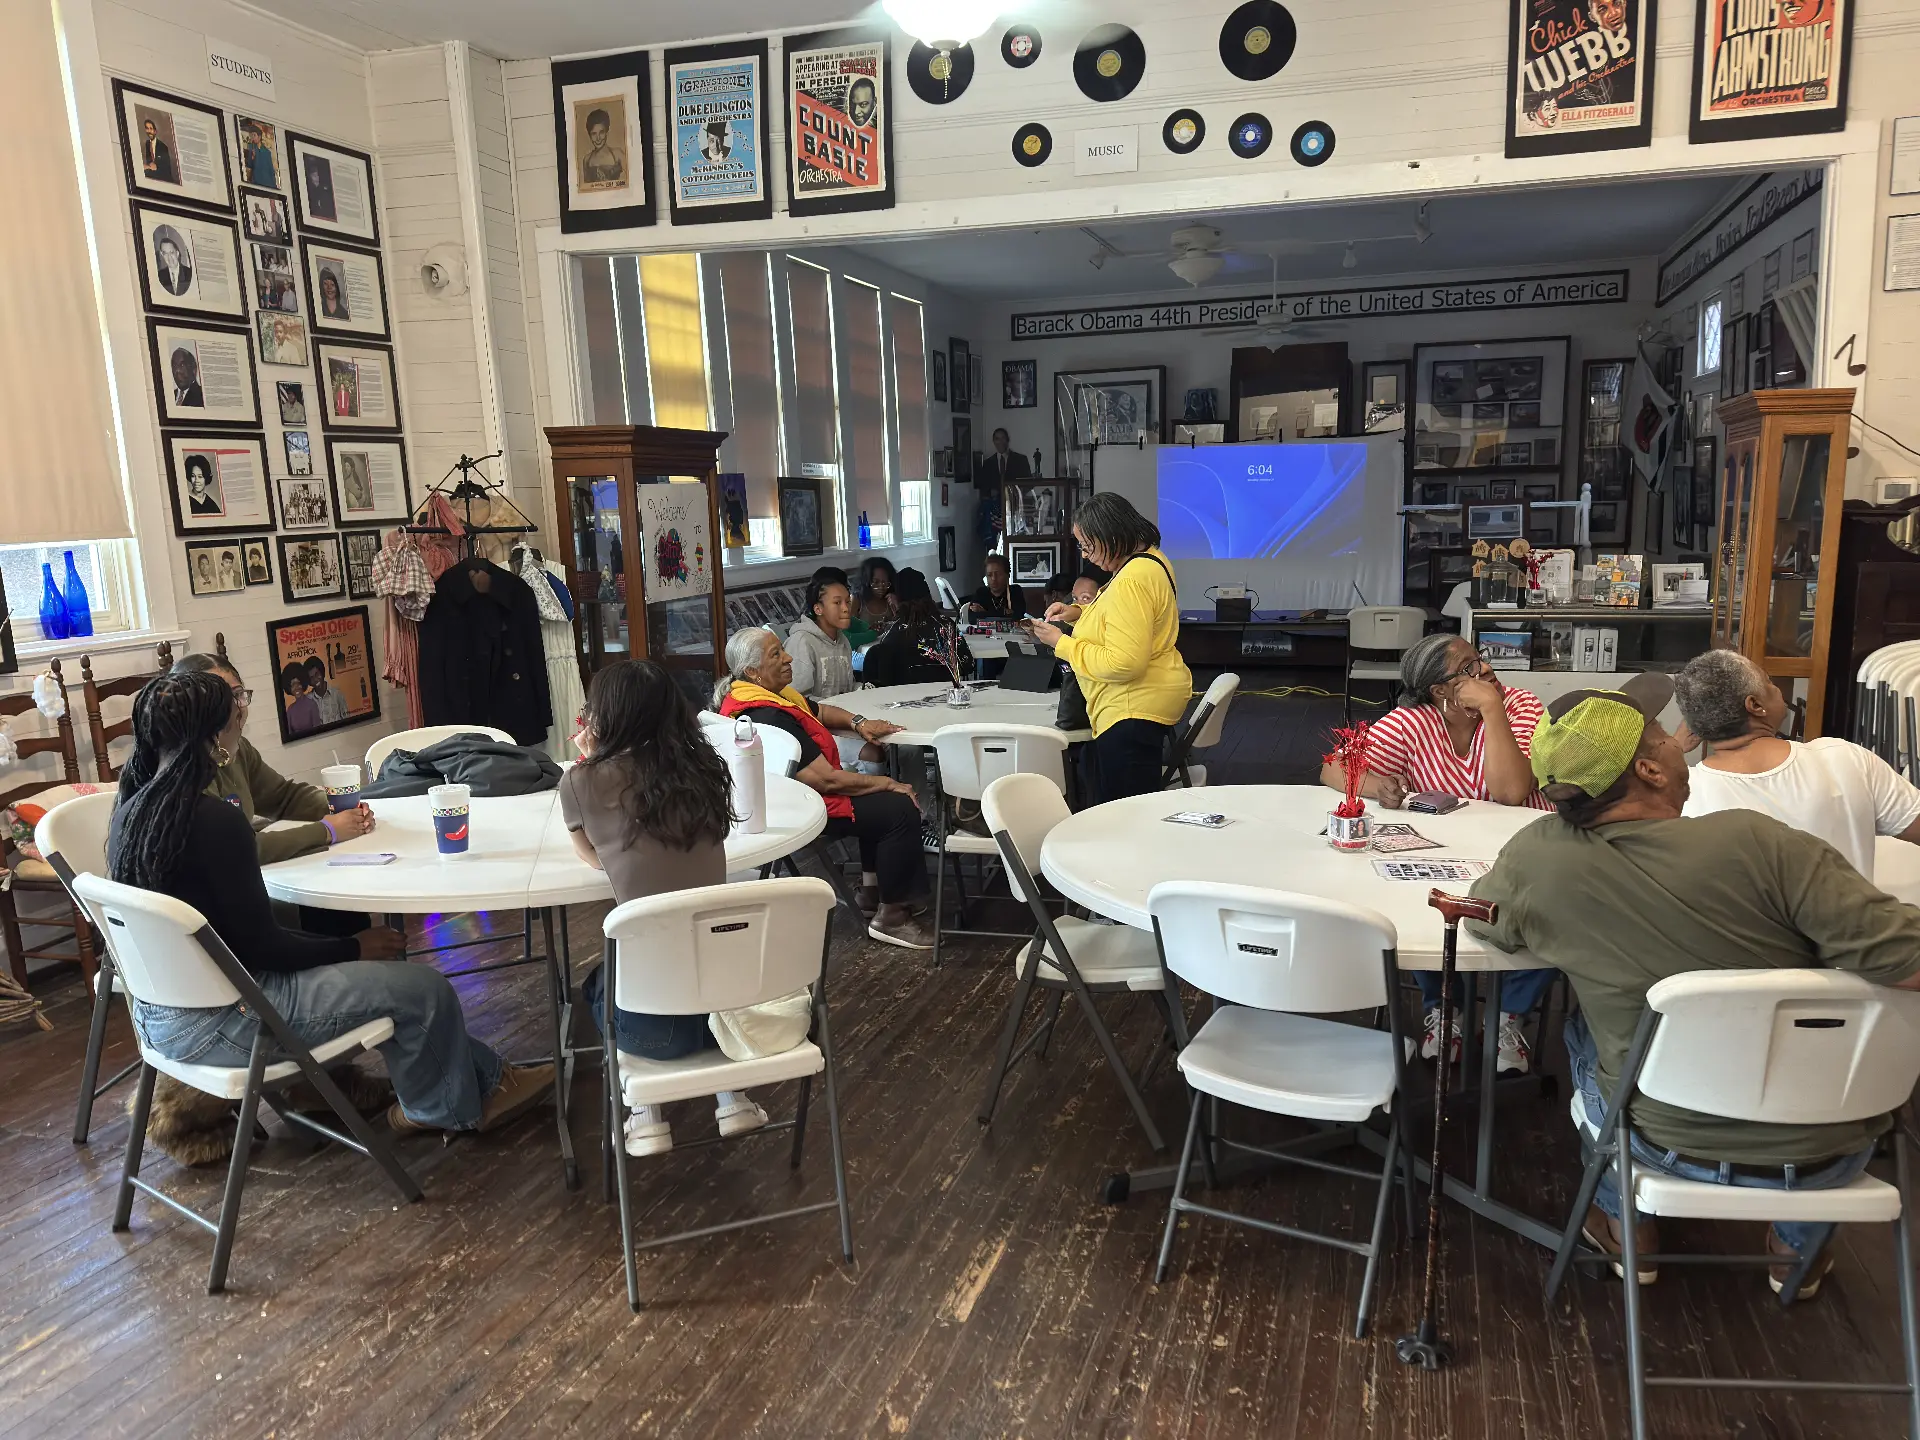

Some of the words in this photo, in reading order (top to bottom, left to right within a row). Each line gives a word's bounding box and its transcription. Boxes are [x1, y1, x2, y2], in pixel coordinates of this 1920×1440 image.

[1531, 8, 1589, 53] Chick
[1524, 22, 1631, 92] WEBB
[1711, 20, 1832, 101] ARMSTRONG
[211, 54, 272, 84] STUDENTS
[796, 61, 830, 74] APPEARING
[831, 60, 838, 69] AT
[1589, 57, 1636, 83] Orchestra
[684, 75, 746, 92] GRAYSTONE
[796, 80, 806, 89] IN
[810, 75, 850, 88] PERSON
[678, 103, 702, 117] DUKE
[703, 99, 753, 115] ELLINGTON
[1741, 94, 1799, 106] ORCHESTRA
[679, 118, 694, 126] AND
[707, 112, 752, 123] ORCHESTRA
[1562, 110, 1582, 120] ELLA
[1583, 106, 1635, 119] FITZGERALD
[799, 103, 873, 155] COUNT
[803, 131, 869, 181] BASIE
[1088, 144, 1124, 157] MUSIC
[800, 168, 843, 184] ORCHESTRA
[1016, 313, 1075, 335] Barack
[1080, 312, 1143, 330] Obama
[1150, 307, 1191, 326] 44th
[1293, 296, 1314, 316] of
[1320, 296, 1351, 315] the
[1359, 292, 1424, 312] United
[1432, 289, 1496, 308] States
[1503, 284, 1526, 303] of
[1532, 280, 1619, 302] America
[1005, 364, 1033, 373] OBAMA
[1247, 464, 1273, 475] 6:04
[279, 623, 327, 646] Special
[328, 618, 359, 635] Offer
[287, 650, 302, 659] AFRO
[303, 647, 317, 657] PICK
[714, 923, 746, 932] LIFETIME
